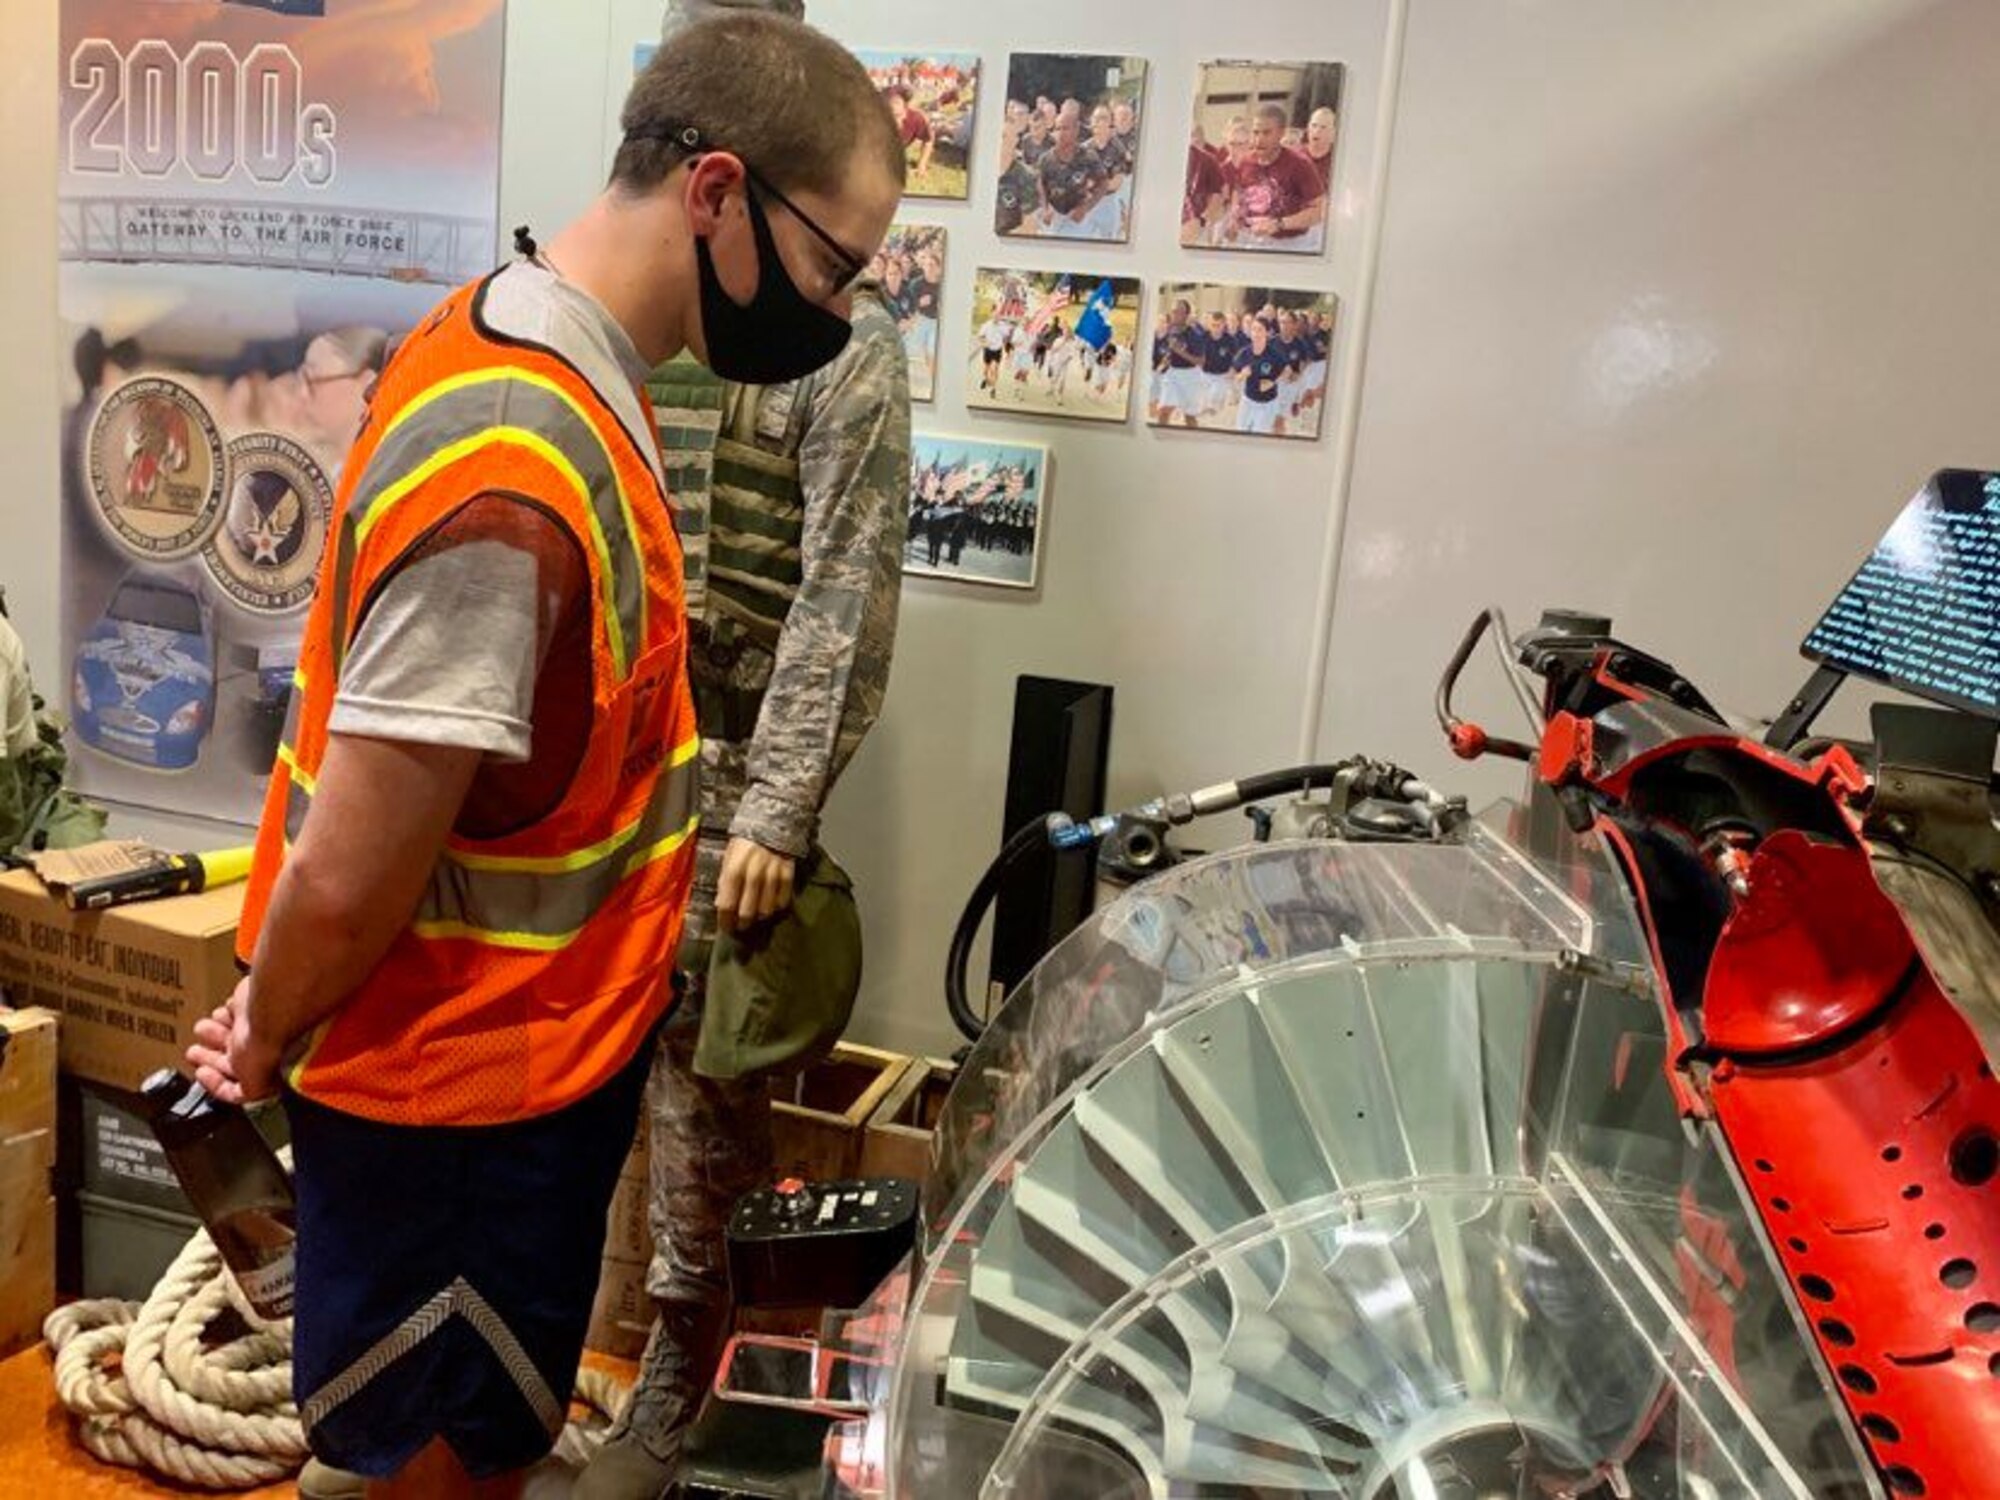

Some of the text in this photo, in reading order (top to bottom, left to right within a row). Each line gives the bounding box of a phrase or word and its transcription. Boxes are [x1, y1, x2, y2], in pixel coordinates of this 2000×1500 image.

[70, 38, 337, 190] 2000s
[127, 221, 405, 252] GATEWAY TO THE AIR FORCE
[30, 919, 112, 974] READY-TO-EAT,
[113, 943, 184, 990] INDIVIDUAL
[105, 1009, 135, 1034] WHEN
[137, 1016, 177, 1045] FROZEN
